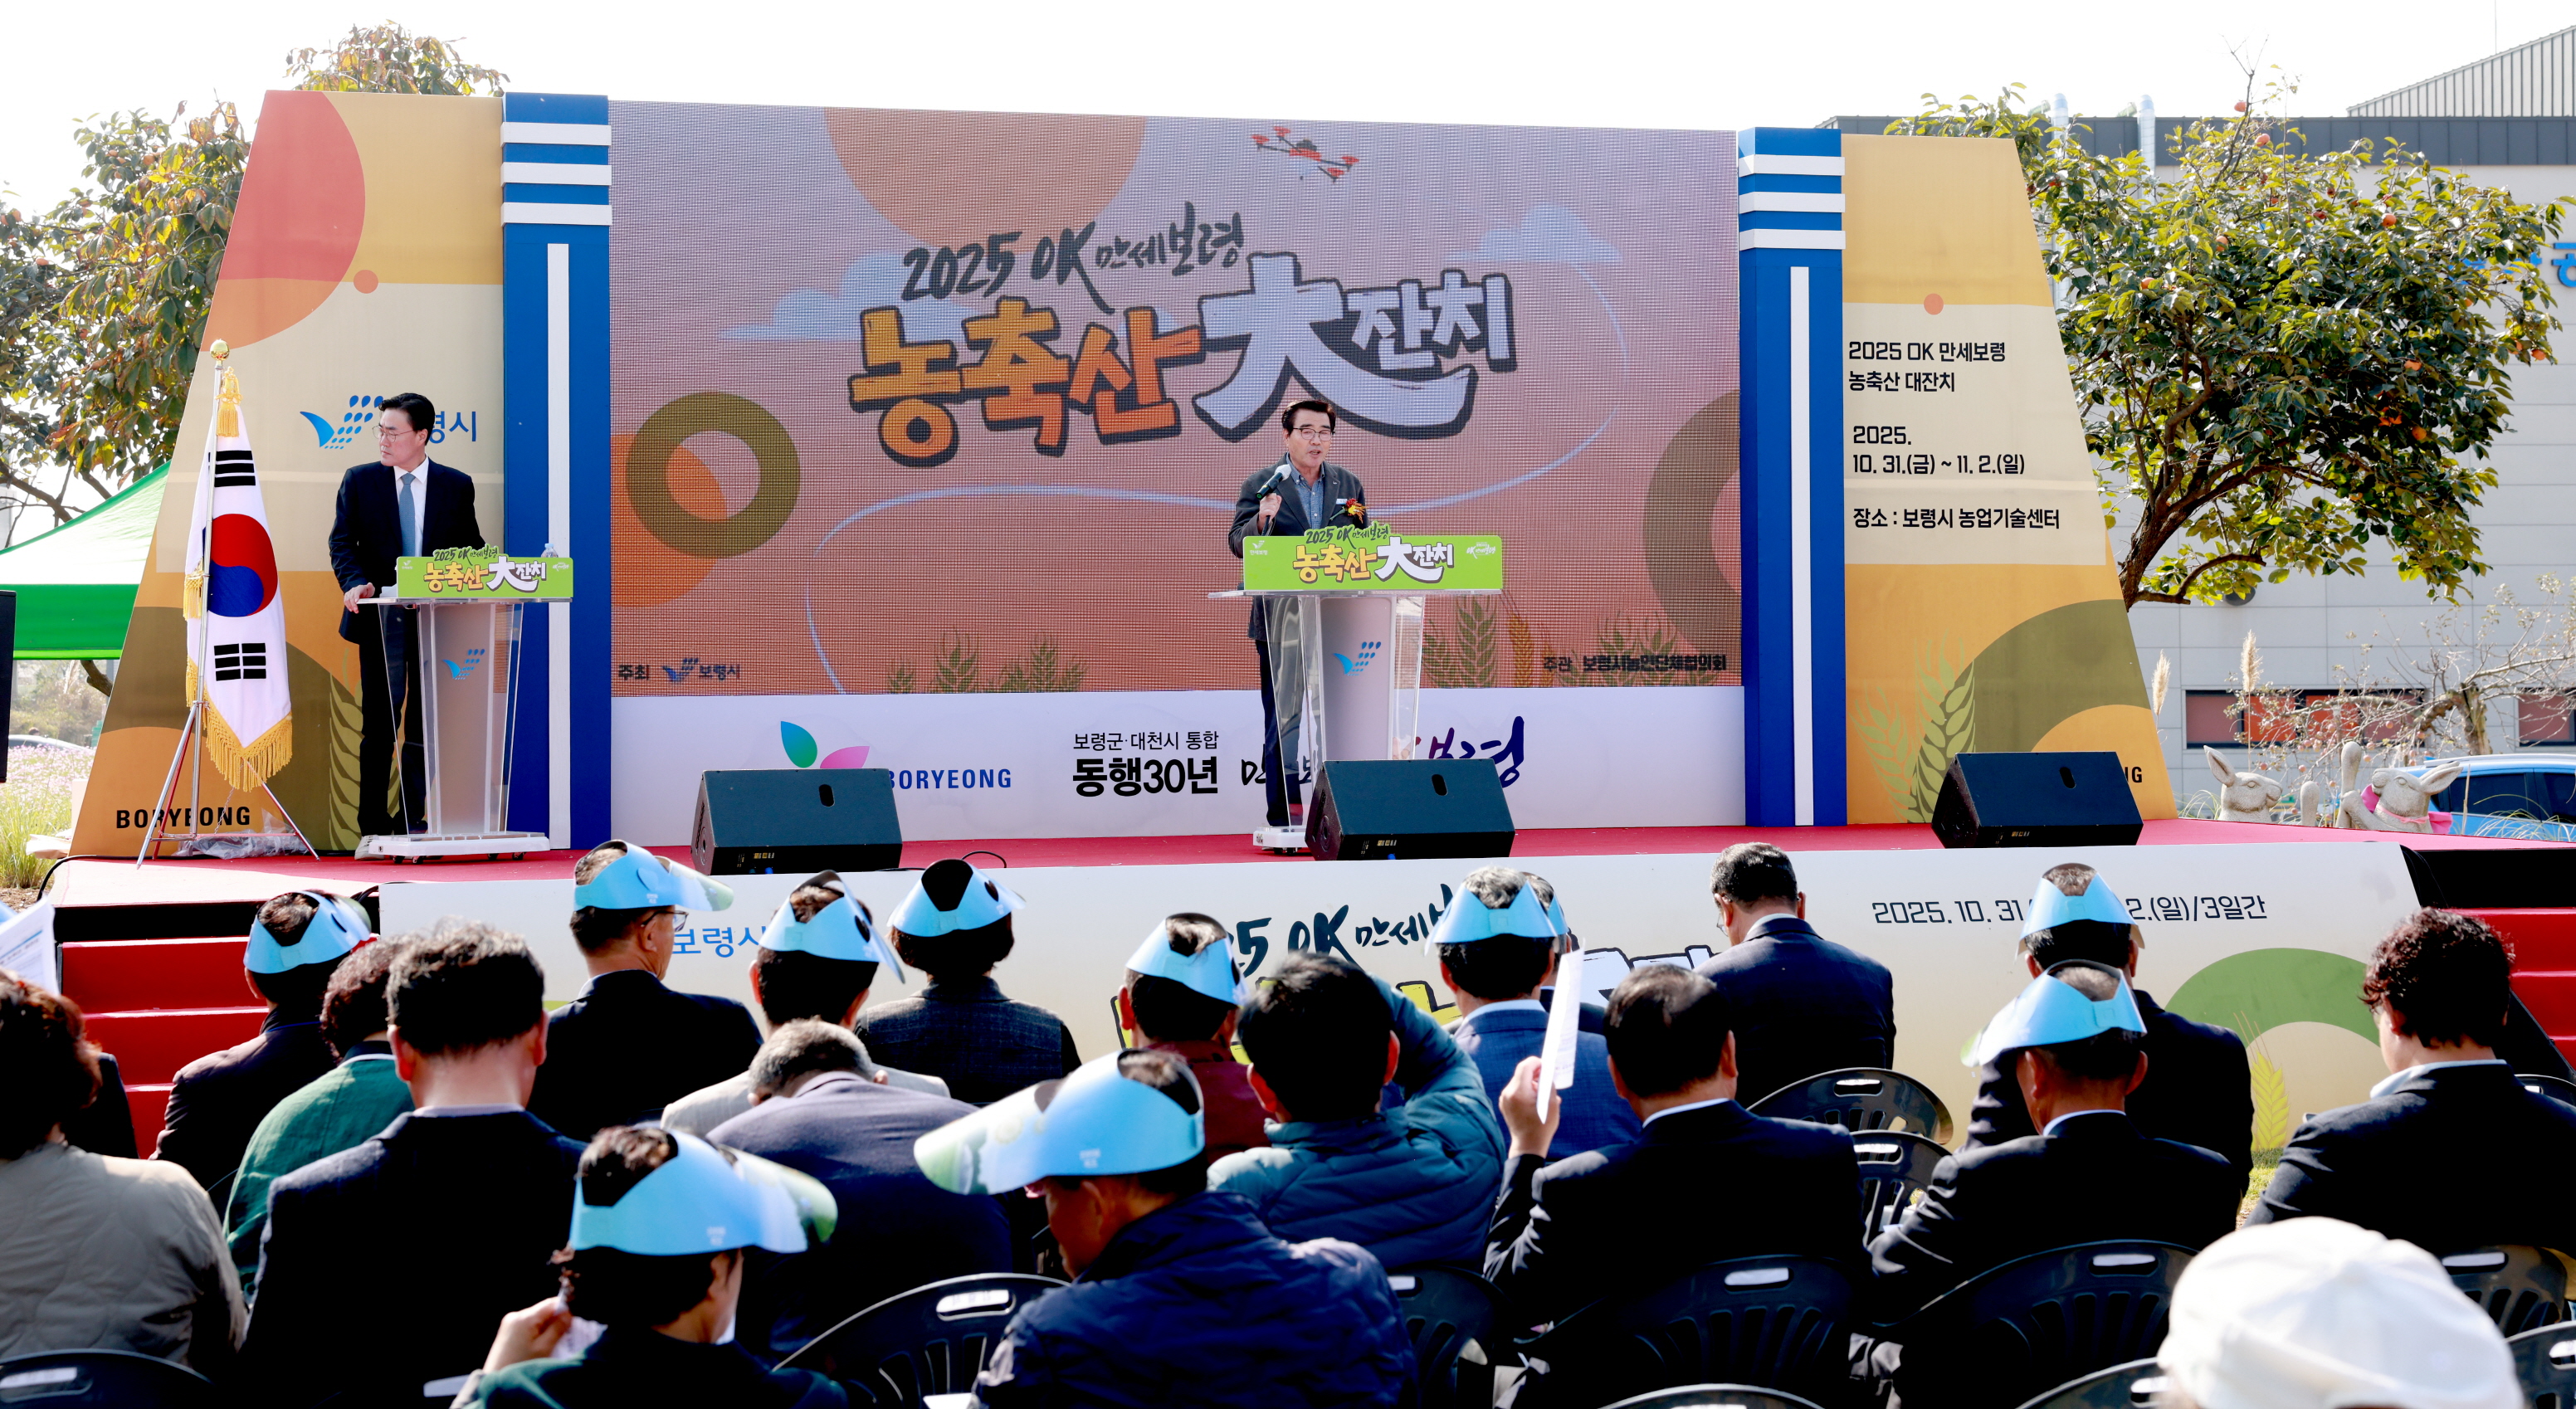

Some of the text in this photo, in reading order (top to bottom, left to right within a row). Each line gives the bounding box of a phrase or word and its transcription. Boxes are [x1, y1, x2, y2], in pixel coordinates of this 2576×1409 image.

[901, 201, 1244, 314] 2025 OK 만세보령
[1848, 341, 2007, 362] 2025 OK 만세보령
[848, 295, 1203, 467] 농축산
[1848, 370, 1955, 392] 농축산 대잔치
[1853, 426, 1912, 446] 2025.
[1853, 454, 1877, 474] 10.
[1882, 454, 1935, 475] 31.(금)
[1957, 455, 1973, 474] 11.
[1978, 453, 2025, 475] 2.(일)
[1852, 508, 1888, 529] 장소
[1902, 508, 1954, 529] 보령시
[1959, 508, 2060, 529] 농업기술센터
[1305, 522, 1388, 549] 2025 OK 만세보령
[434, 549, 456, 562] 2025
[457, 546, 473, 566] OK
[1292, 543, 1378, 583] 농축산
[423, 561, 490, 593] 농축산
[618, 664, 740, 681] 주최 보령시
[1544, 656, 1572, 672] 주관
[1186, 731, 1219, 750] 통합
[1072, 756, 1218, 797] 동행30년
[1872, 900, 1952, 924] 2025.
[1954, 900, 1992, 923] 10.
